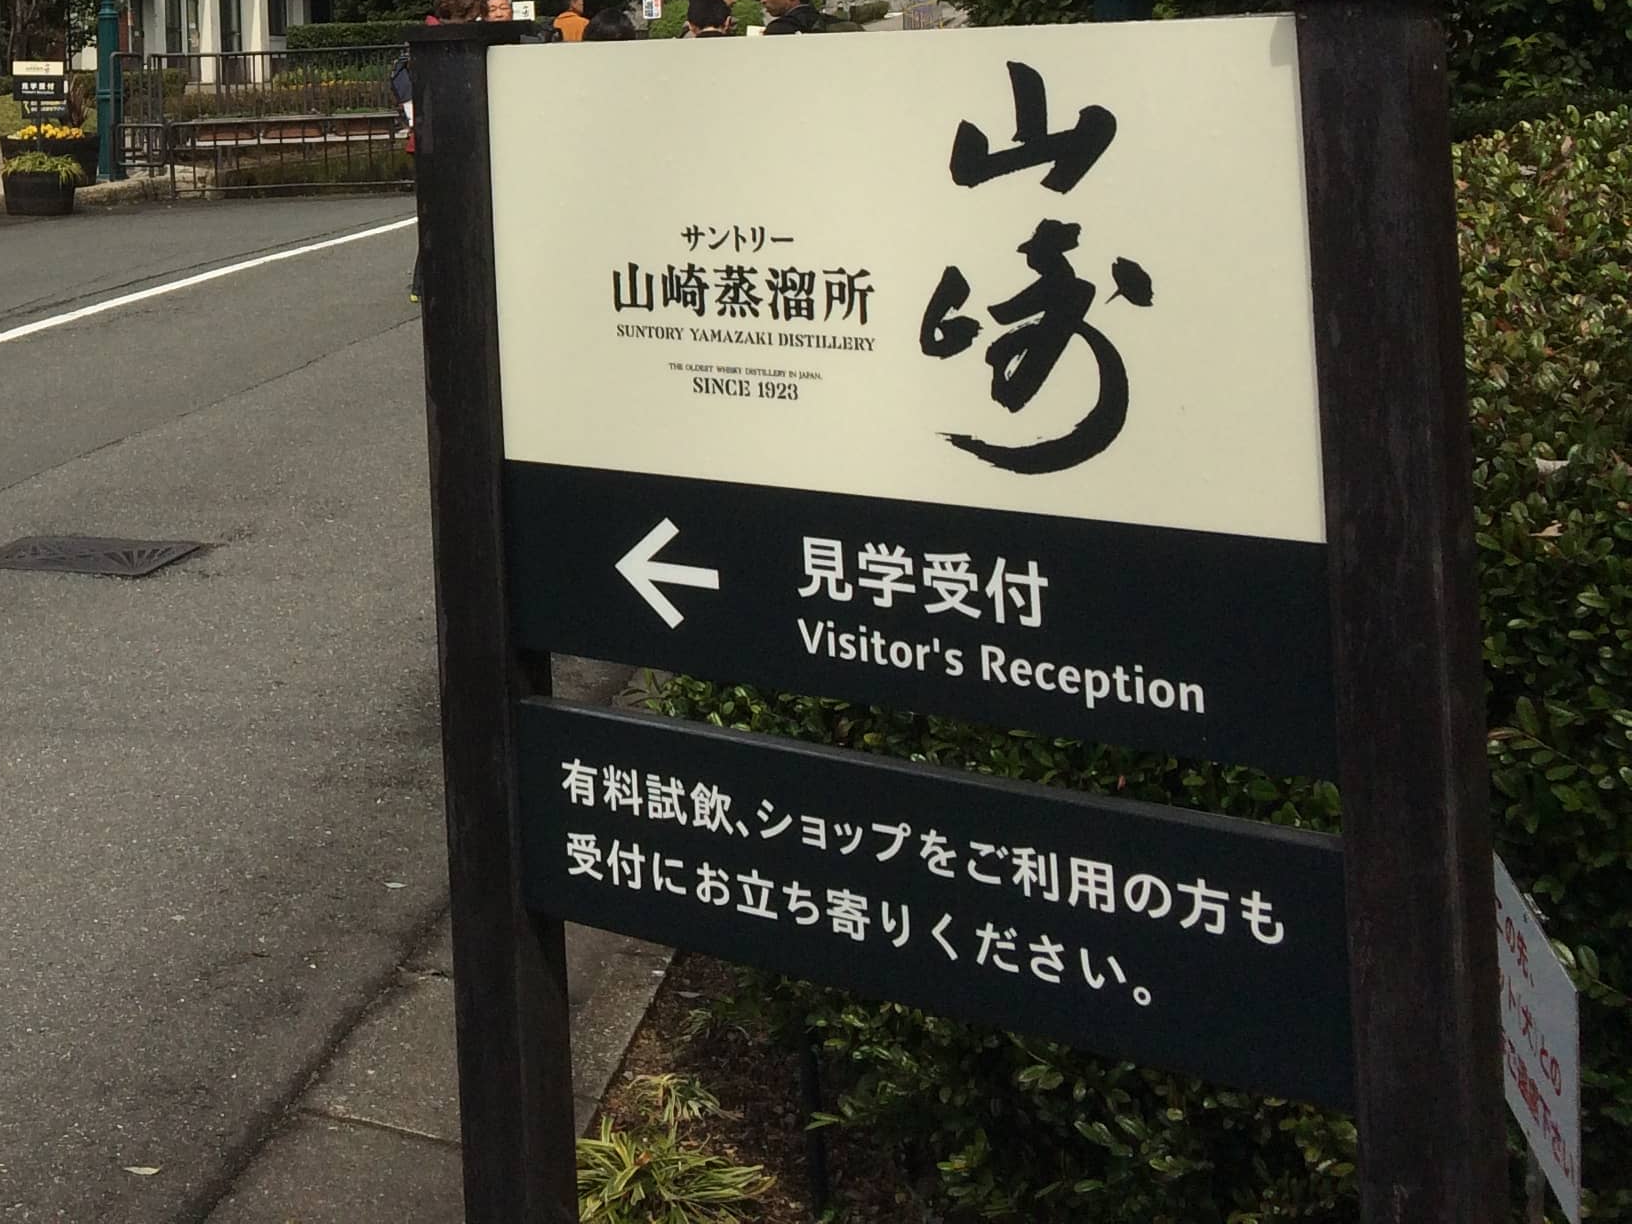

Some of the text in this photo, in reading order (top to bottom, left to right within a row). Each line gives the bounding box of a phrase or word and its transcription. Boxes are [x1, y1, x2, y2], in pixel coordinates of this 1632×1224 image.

[680, 224, 795, 253] サントリー
[920, 60, 1155, 476] 山崎
[612, 260, 875, 327] 山崎蒸溜所
[616, 324, 876, 352] SUNTORY YAMAZAKI DISTILLERY
[668, 362, 683, 371] THE
[685, 363, 713, 373] OLDEST
[716, 366, 743, 375] WHISKY
[745, 367, 786, 378] DISTILLERY
[788, 370, 797, 378] IN
[692, 376, 799, 401] SINCE 1923
[798, 536, 1049, 628] 見学受付
[798, 618, 1206, 714] Visitor's Reception
[562, 758, 1286, 946] 有料試飲、ショップをご利用の方も
[566, 832, 1154, 1007] 受付にお立ち寄りください。
